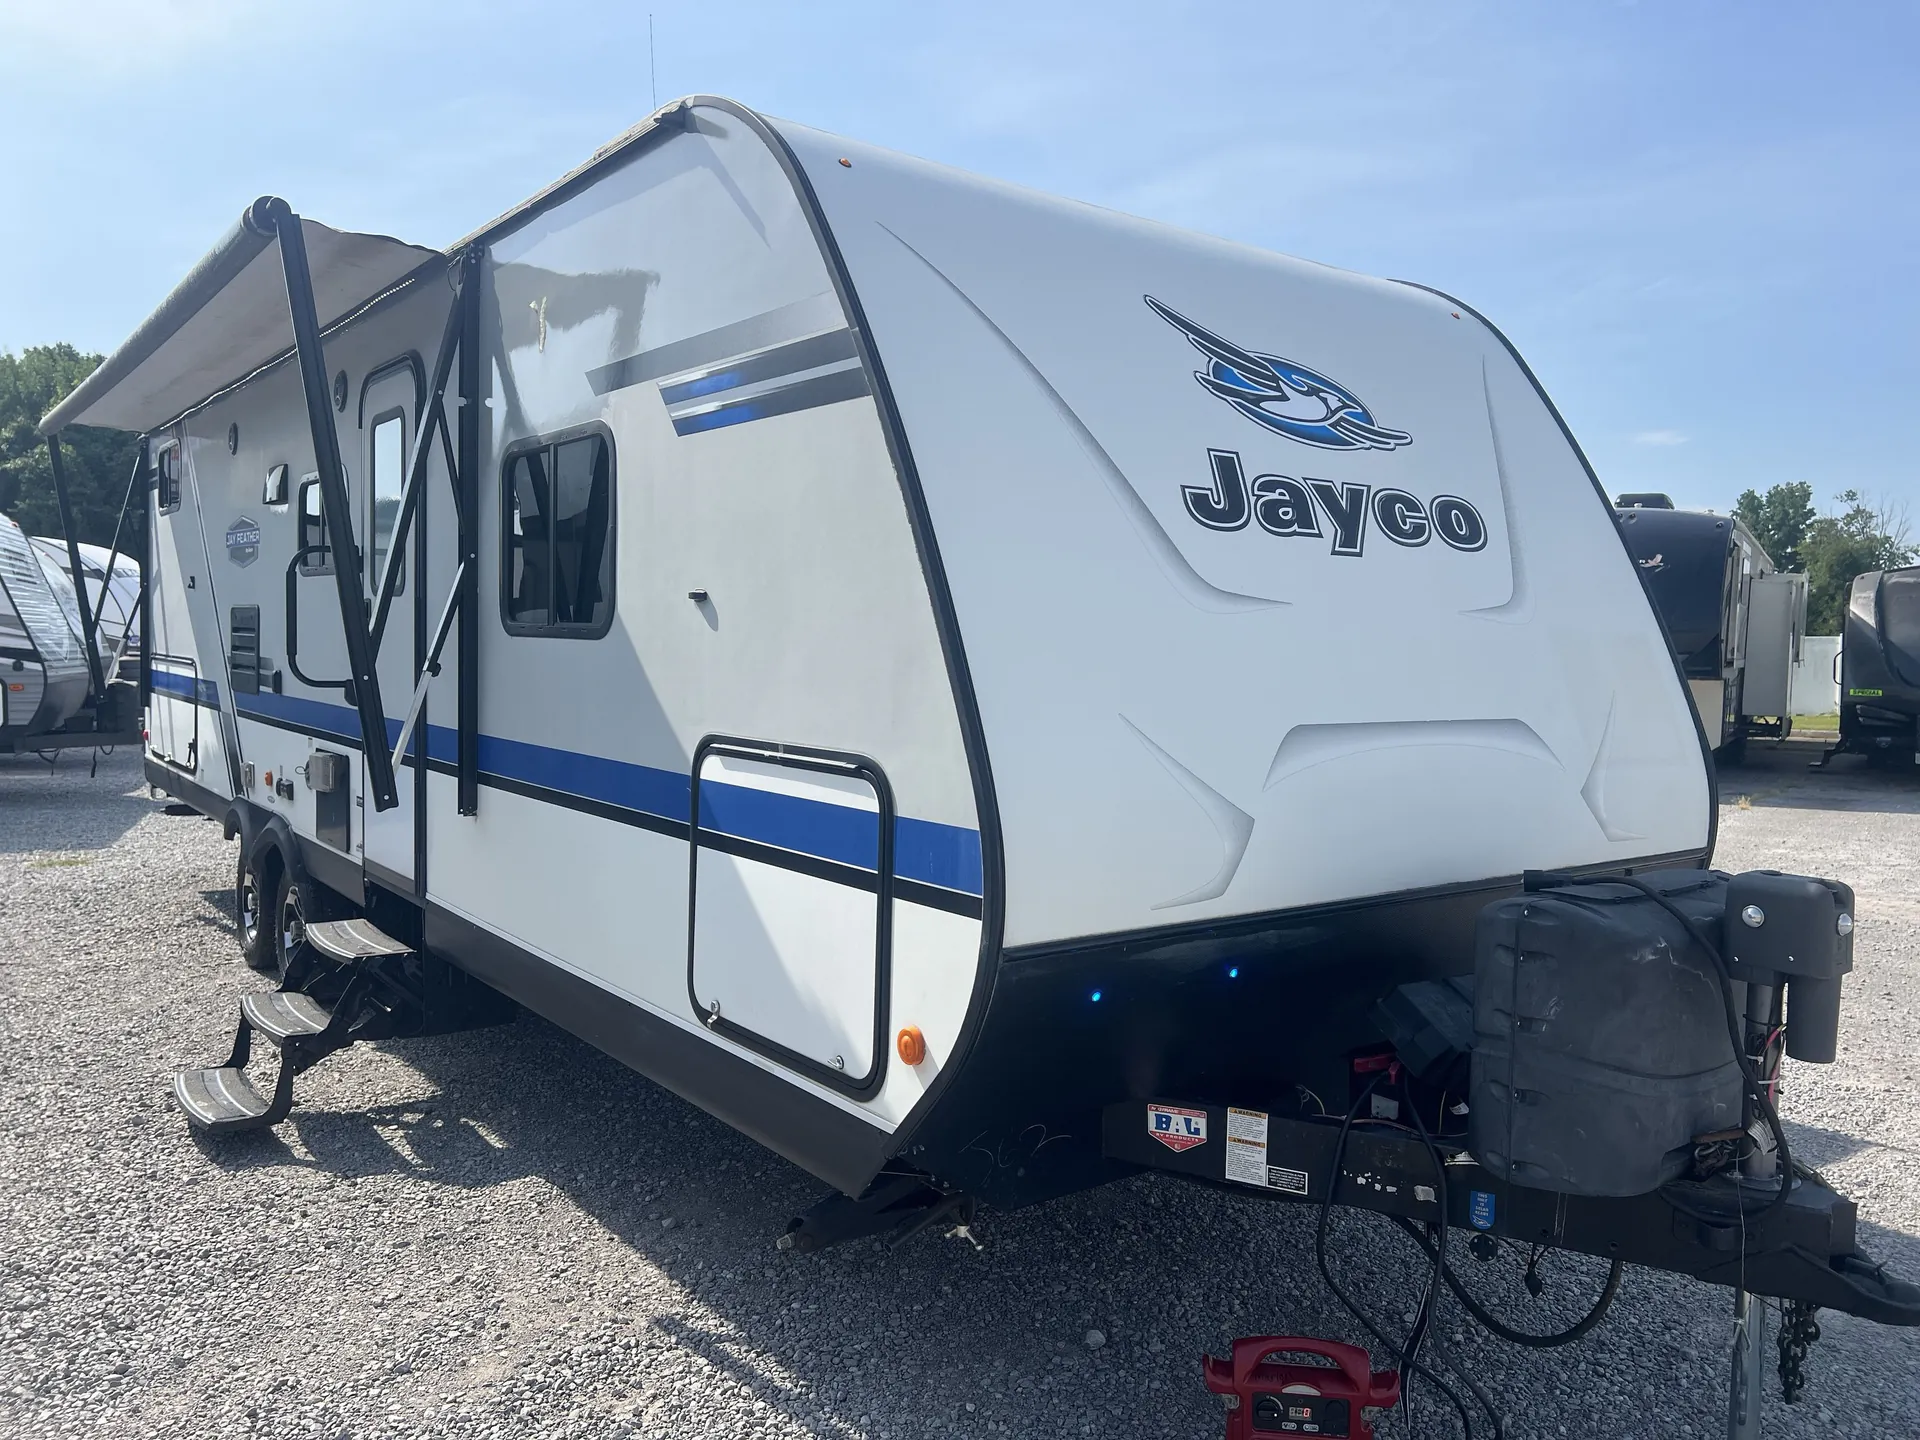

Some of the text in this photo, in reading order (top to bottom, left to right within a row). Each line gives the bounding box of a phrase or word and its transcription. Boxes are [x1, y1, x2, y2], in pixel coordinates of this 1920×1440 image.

[1180, 448, 1488, 557] Jayco
[227, 530, 259, 545] JAY FEATHER
[1238, 1109, 1262, 1118] WARNING
[1154, 1113, 1201, 1136] BAL
[1166, 1134, 1199, 1142] PRODUCTS
[1237, 1138, 1261, 1147] WARNING
